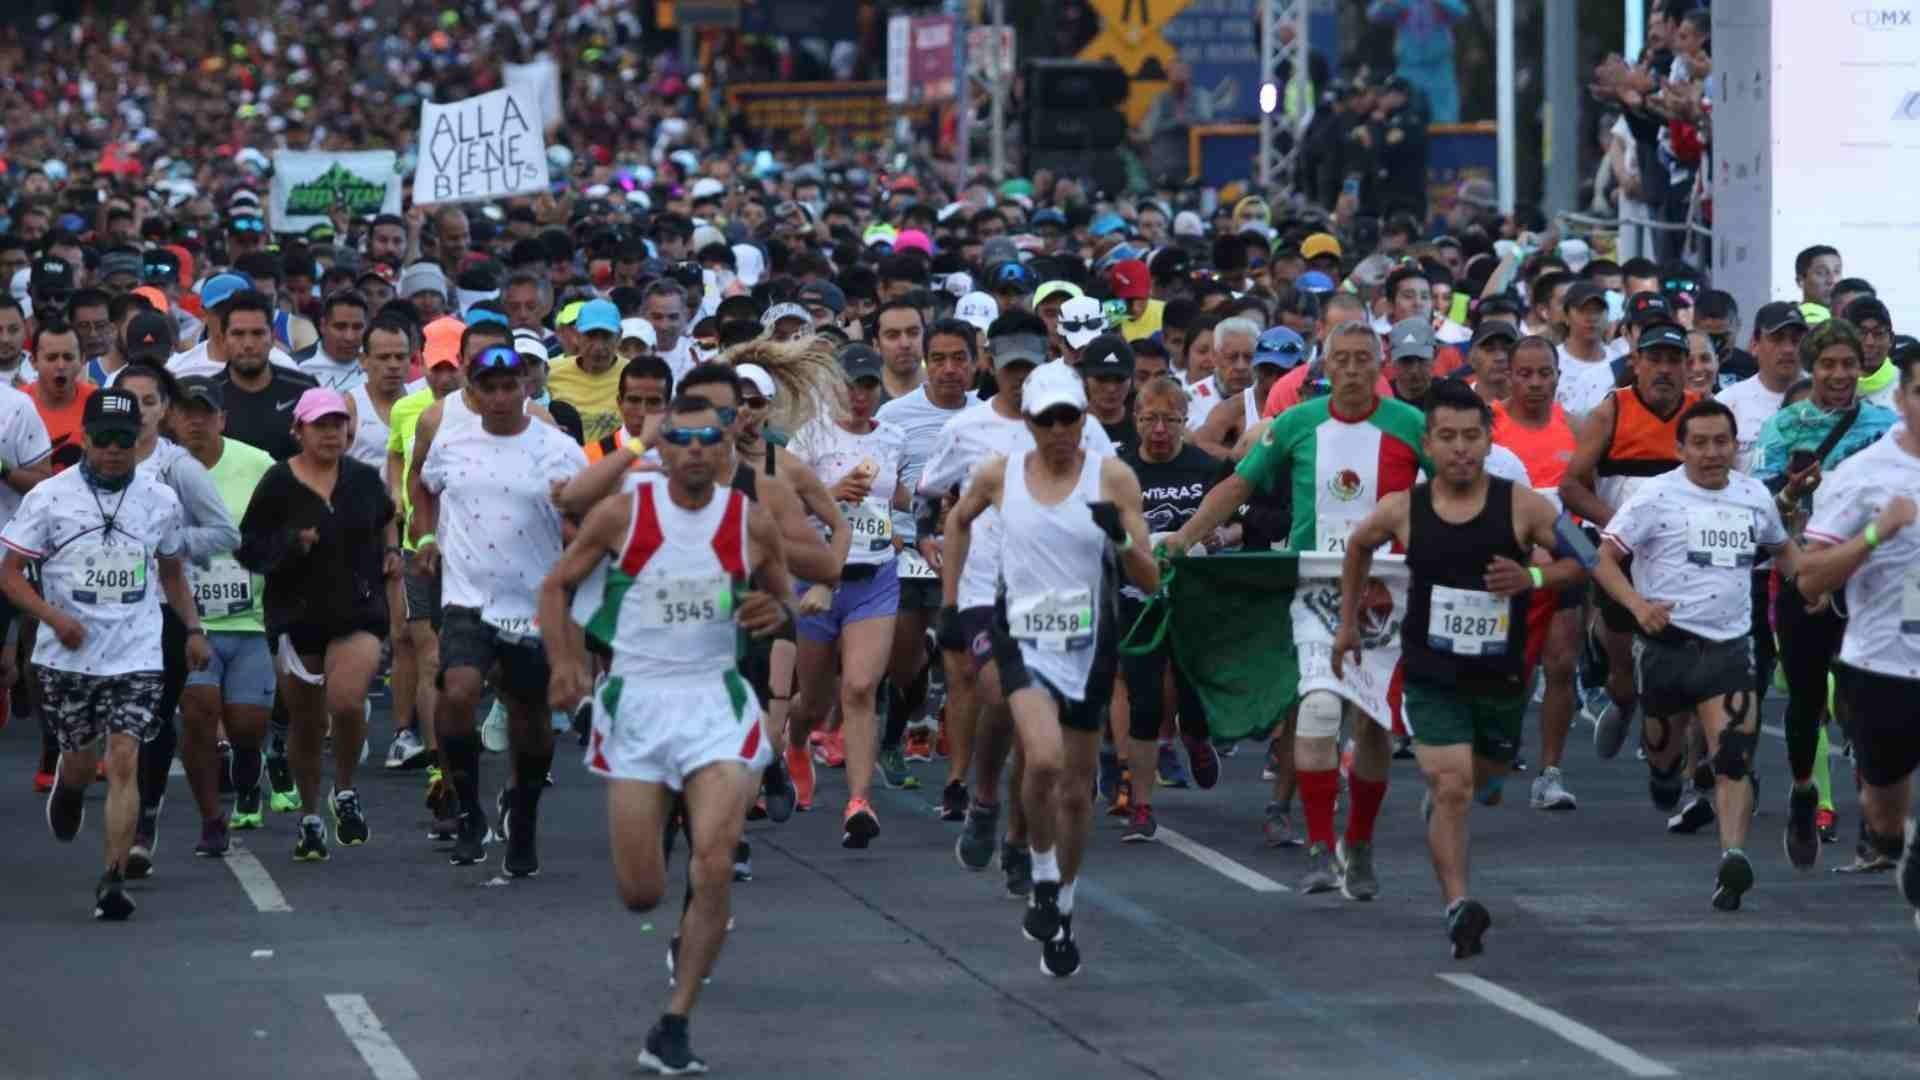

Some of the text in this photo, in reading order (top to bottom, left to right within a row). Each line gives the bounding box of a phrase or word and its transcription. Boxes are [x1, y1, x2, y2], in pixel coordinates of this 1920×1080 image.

[1849, 10, 1912, 26] CDMX
[430, 95, 529, 142] ALLA
[430, 134, 526, 174] VIENE
[1701, 530, 1748, 549] 10902
[85, 570, 136, 588] 24081
[193, 583, 240, 601] 26918
[662, 601, 715, 623] 3545
[1024, 613, 1080, 633] 15258
[1443, 614, 1499, 636] 18287
